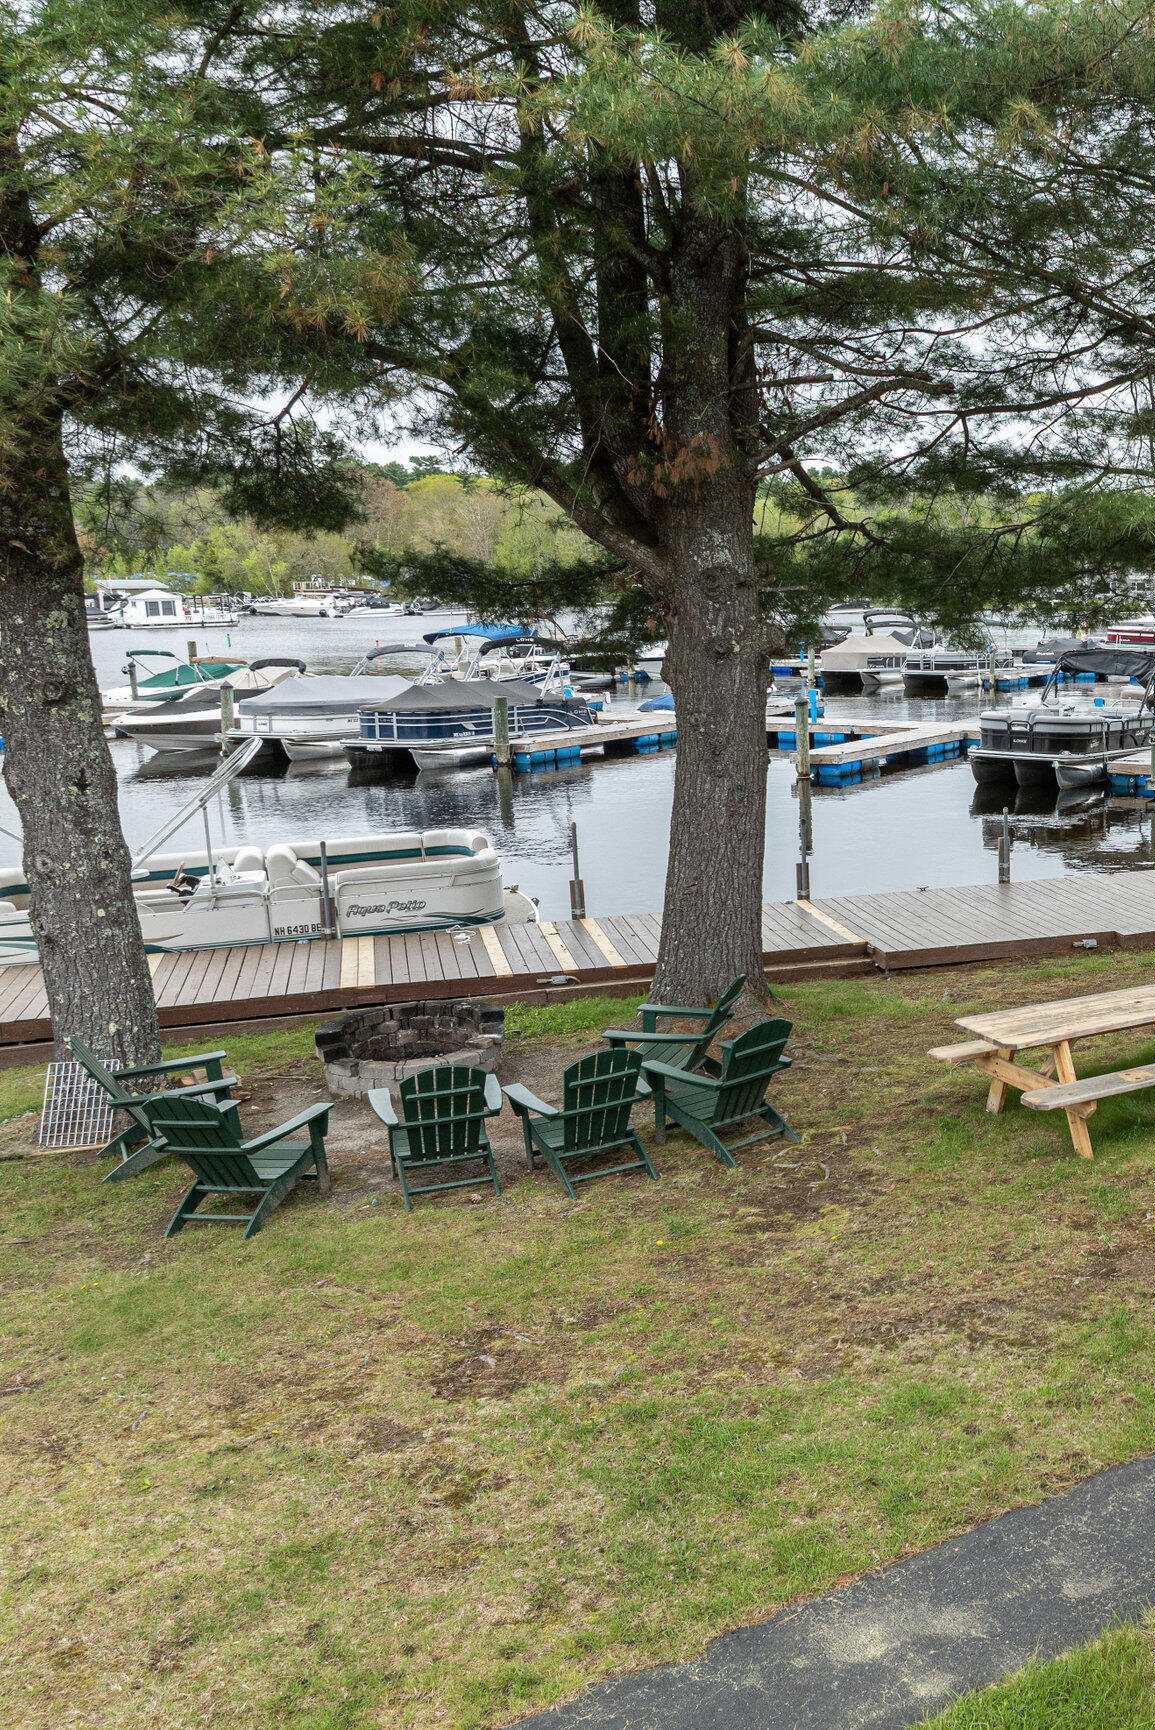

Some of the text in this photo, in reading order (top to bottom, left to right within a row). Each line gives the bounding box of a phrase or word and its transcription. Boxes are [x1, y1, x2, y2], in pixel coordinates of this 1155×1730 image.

[346, 899, 427, 918] Aqua Patio
[274, 926, 286, 936] NH
[286, 924, 310, 935] 6430
